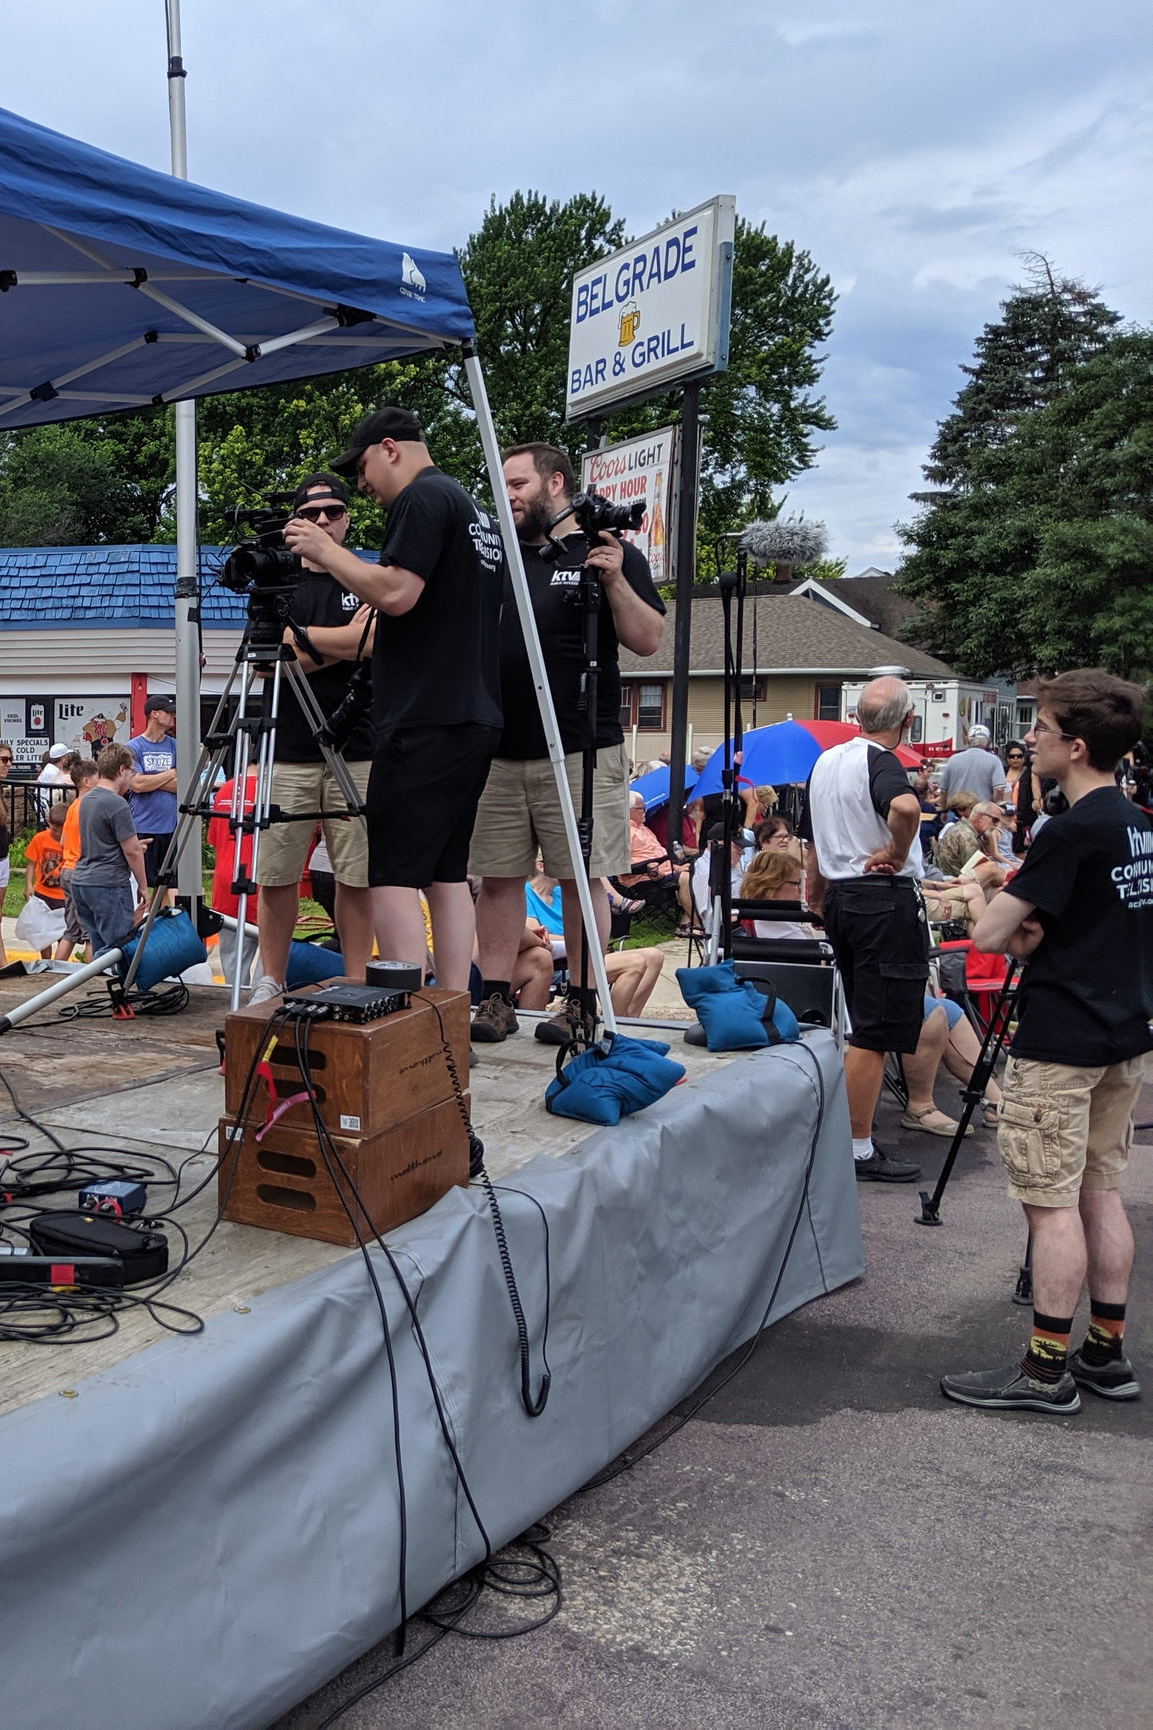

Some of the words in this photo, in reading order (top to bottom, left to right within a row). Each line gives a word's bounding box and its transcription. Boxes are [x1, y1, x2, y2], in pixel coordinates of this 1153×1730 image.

[576, 225, 698, 324] BELGRADE
[570, 357, 607, 395] BAR
[612, 350, 626, 377] &
[631, 323, 695, 369] GRILL
[589, 453, 627, 483] Coors
[627, 443, 664, 471] LIGHT
[620, 474, 648, 501] HOUR
[32, 709, 44, 717] Lite
[58, 703, 84, 721] Lite
[15, 746, 36, 754] COLD
